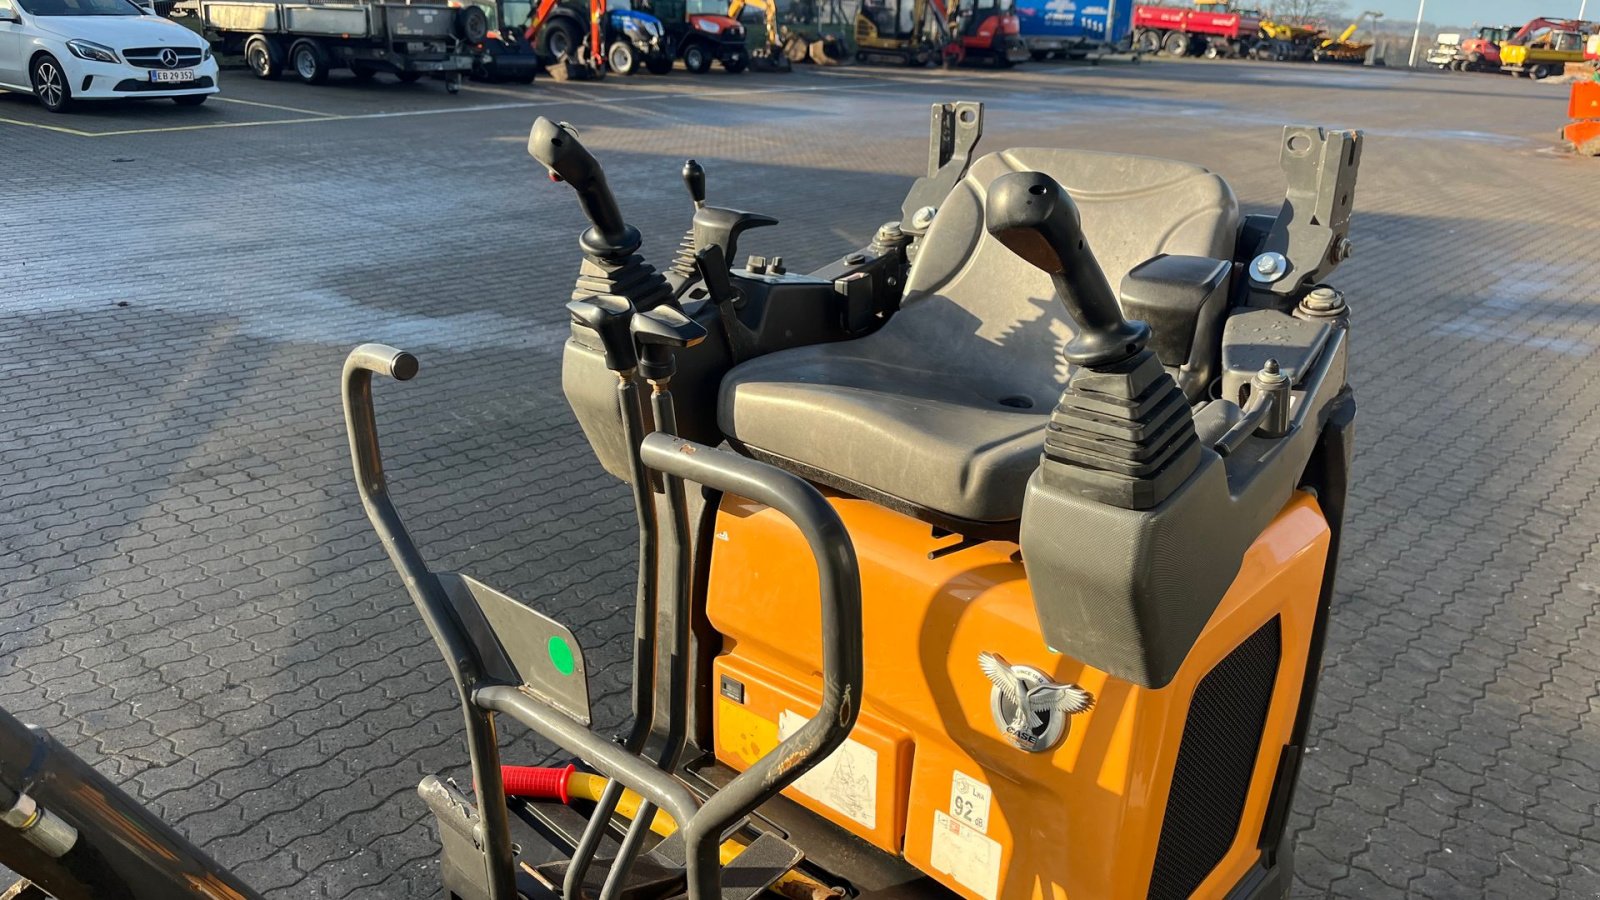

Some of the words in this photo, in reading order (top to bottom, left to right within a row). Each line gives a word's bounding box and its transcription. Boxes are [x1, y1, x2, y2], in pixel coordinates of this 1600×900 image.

[157, 72, 168, 80] EB
[170, 71, 179, 79] 29
[180, 71, 192, 79] 352
[1006, 726, 1038, 744] CASE
[954, 795, 974, 822] 92
